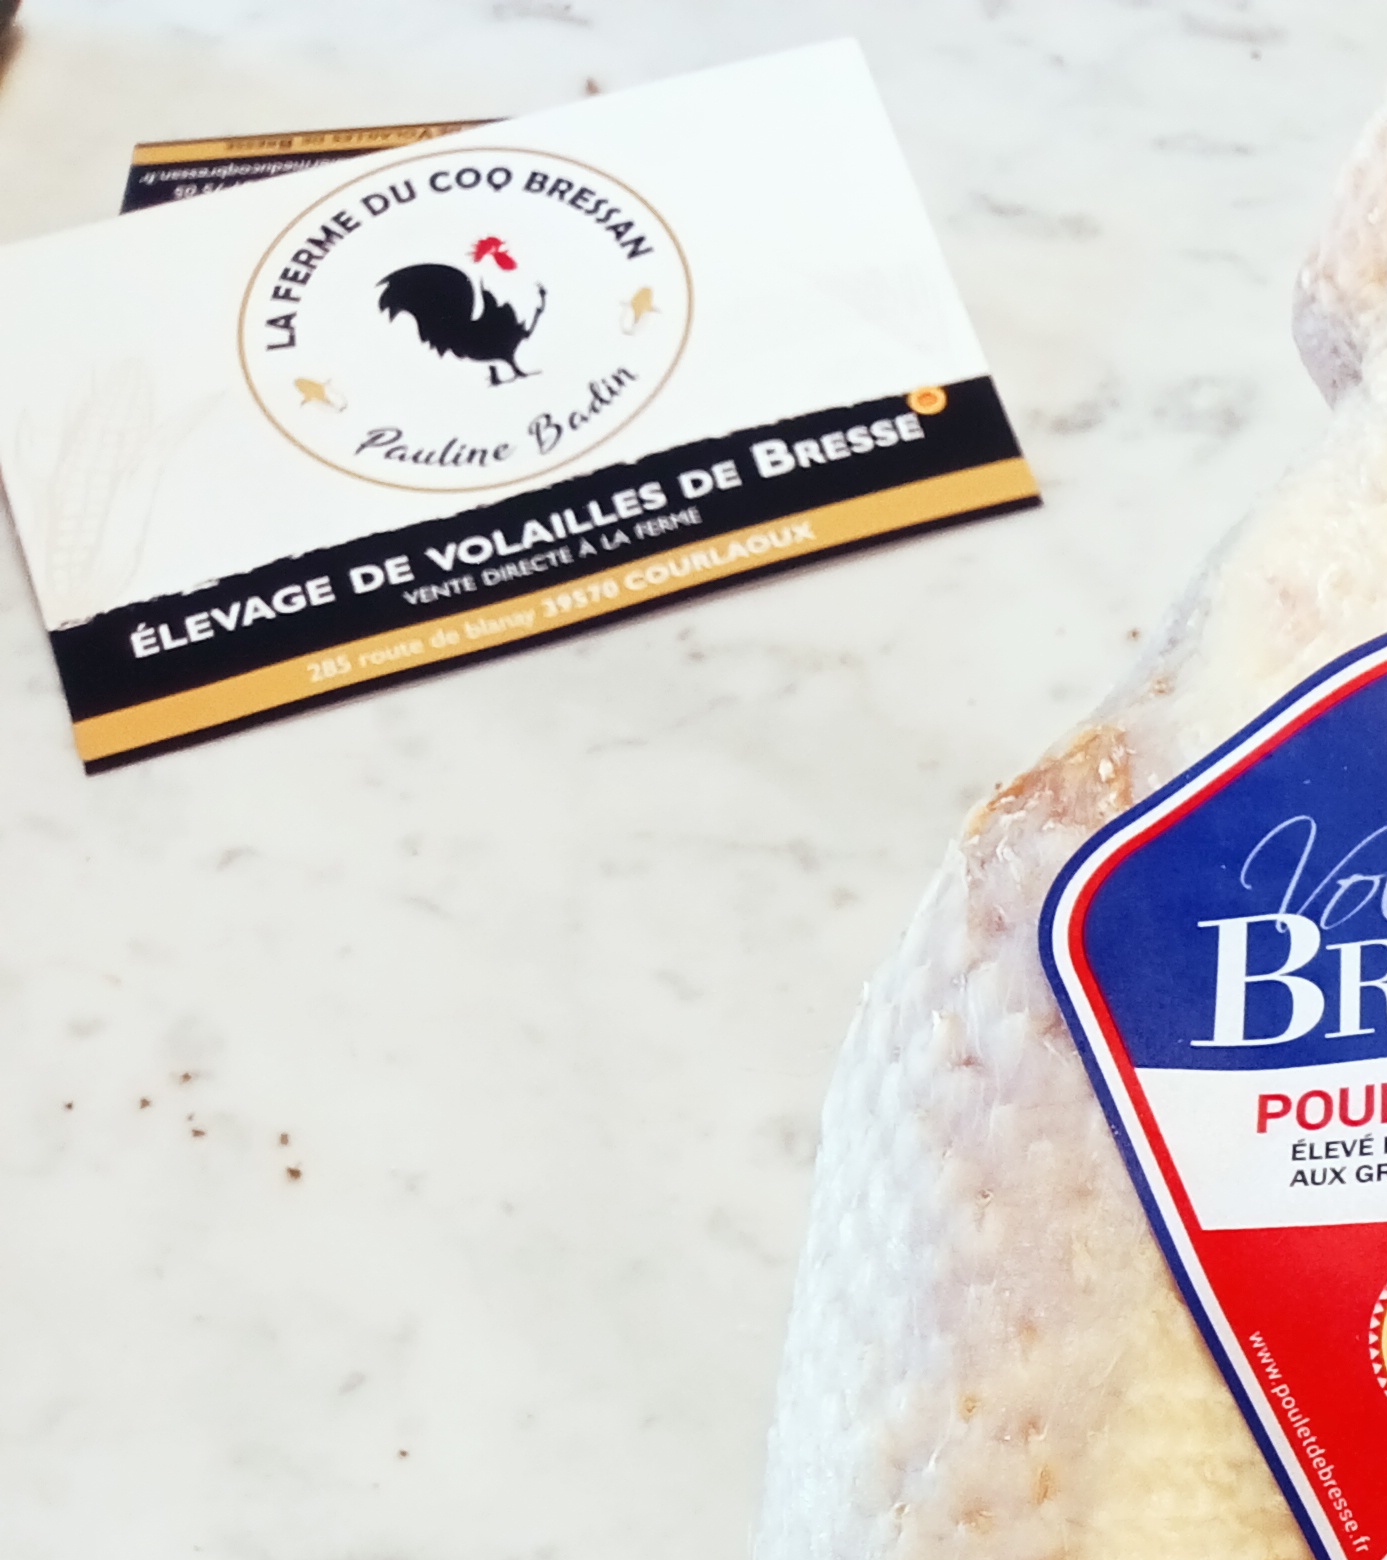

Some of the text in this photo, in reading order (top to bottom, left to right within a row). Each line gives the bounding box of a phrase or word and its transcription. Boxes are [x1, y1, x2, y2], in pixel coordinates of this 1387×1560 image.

[265, 166, 654, 352] LA FERME DU COQ BRESSAN
[354, 365, 638, 467] Pauline Badin
[129, 574, 336, 660] ÉLEVAGE
[348, 555, 415, 596] DE
[424, 481, 667, 573] VOLAILLES
[677, 460, 743, 500] DE
[306, 653, 352, 684] 285
[358, 636, 424, 670] route
[430, 623, 461, 650] de
[624, 521, 818, 592] COURLAOUX
[402, 505, 704, 607] VENTE DIRECTE À LA FERME
[1289, 1166, 1347, 1187] AUX
[1291, 1133, 1374, 1162] ÉLEVÉ
[1247, 1330, 1371, 1553] www.pouletdebresse.fr
